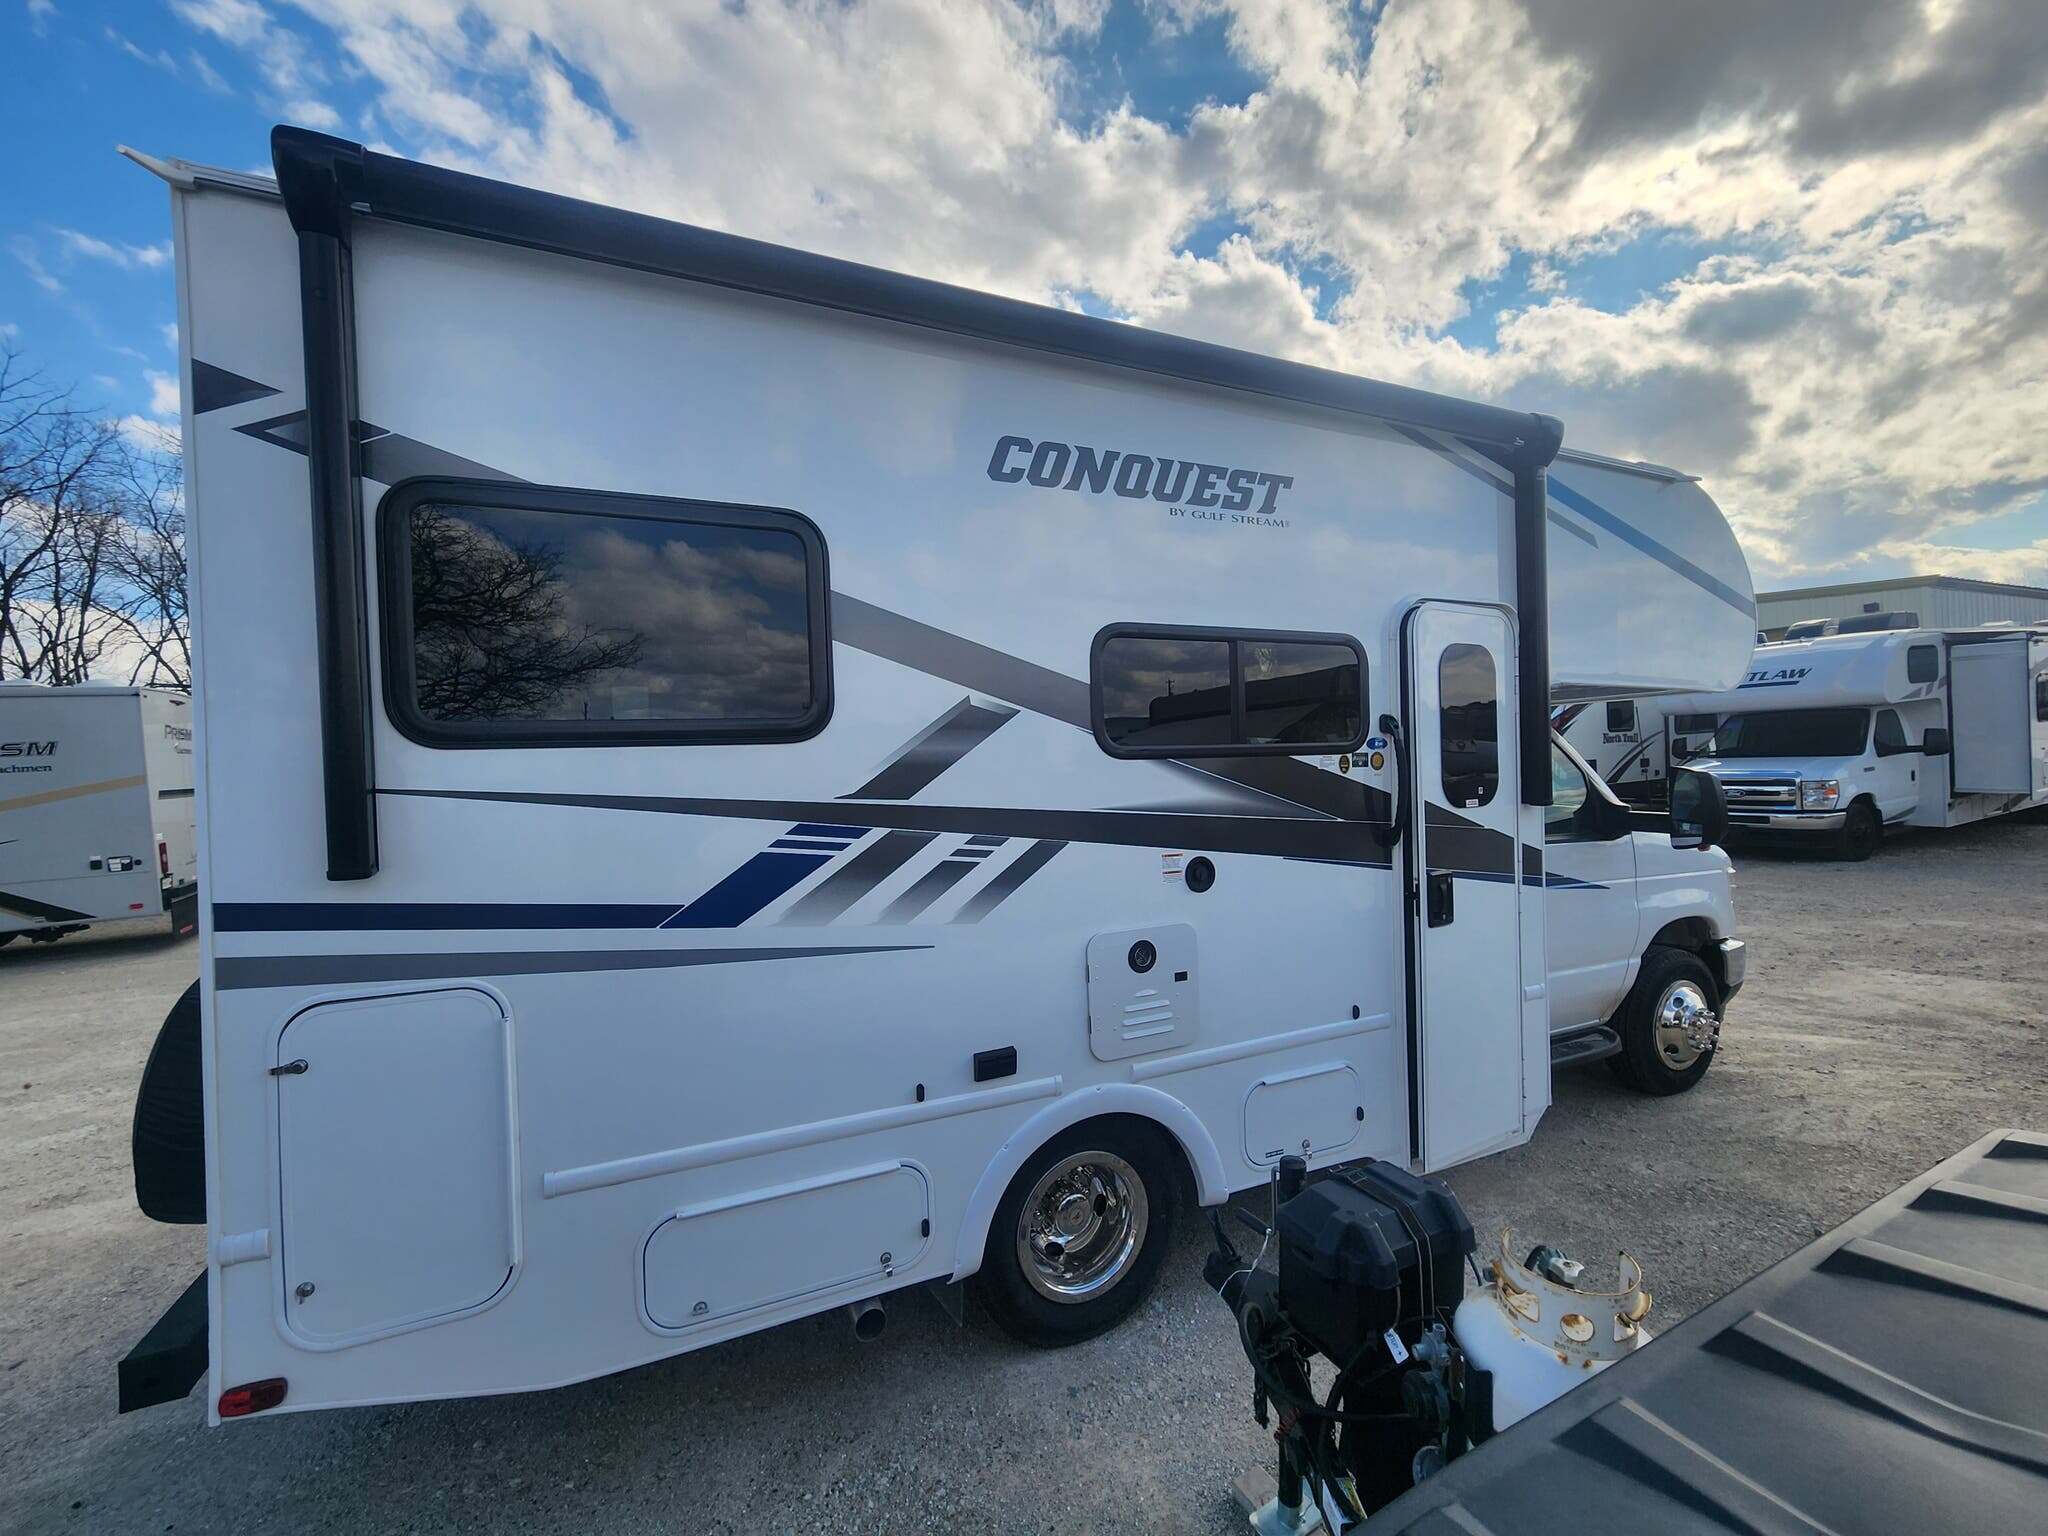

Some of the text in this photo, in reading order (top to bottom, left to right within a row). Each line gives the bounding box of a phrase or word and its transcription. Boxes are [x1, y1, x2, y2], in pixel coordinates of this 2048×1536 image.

[986, 435, 1294, 515] CONQUEST
[1169, 507, 1286, 528] BY GULF STREAM
[1745, 667, 1813, 682] TLAW
[1602, 732, 1639, 744] North Trail
